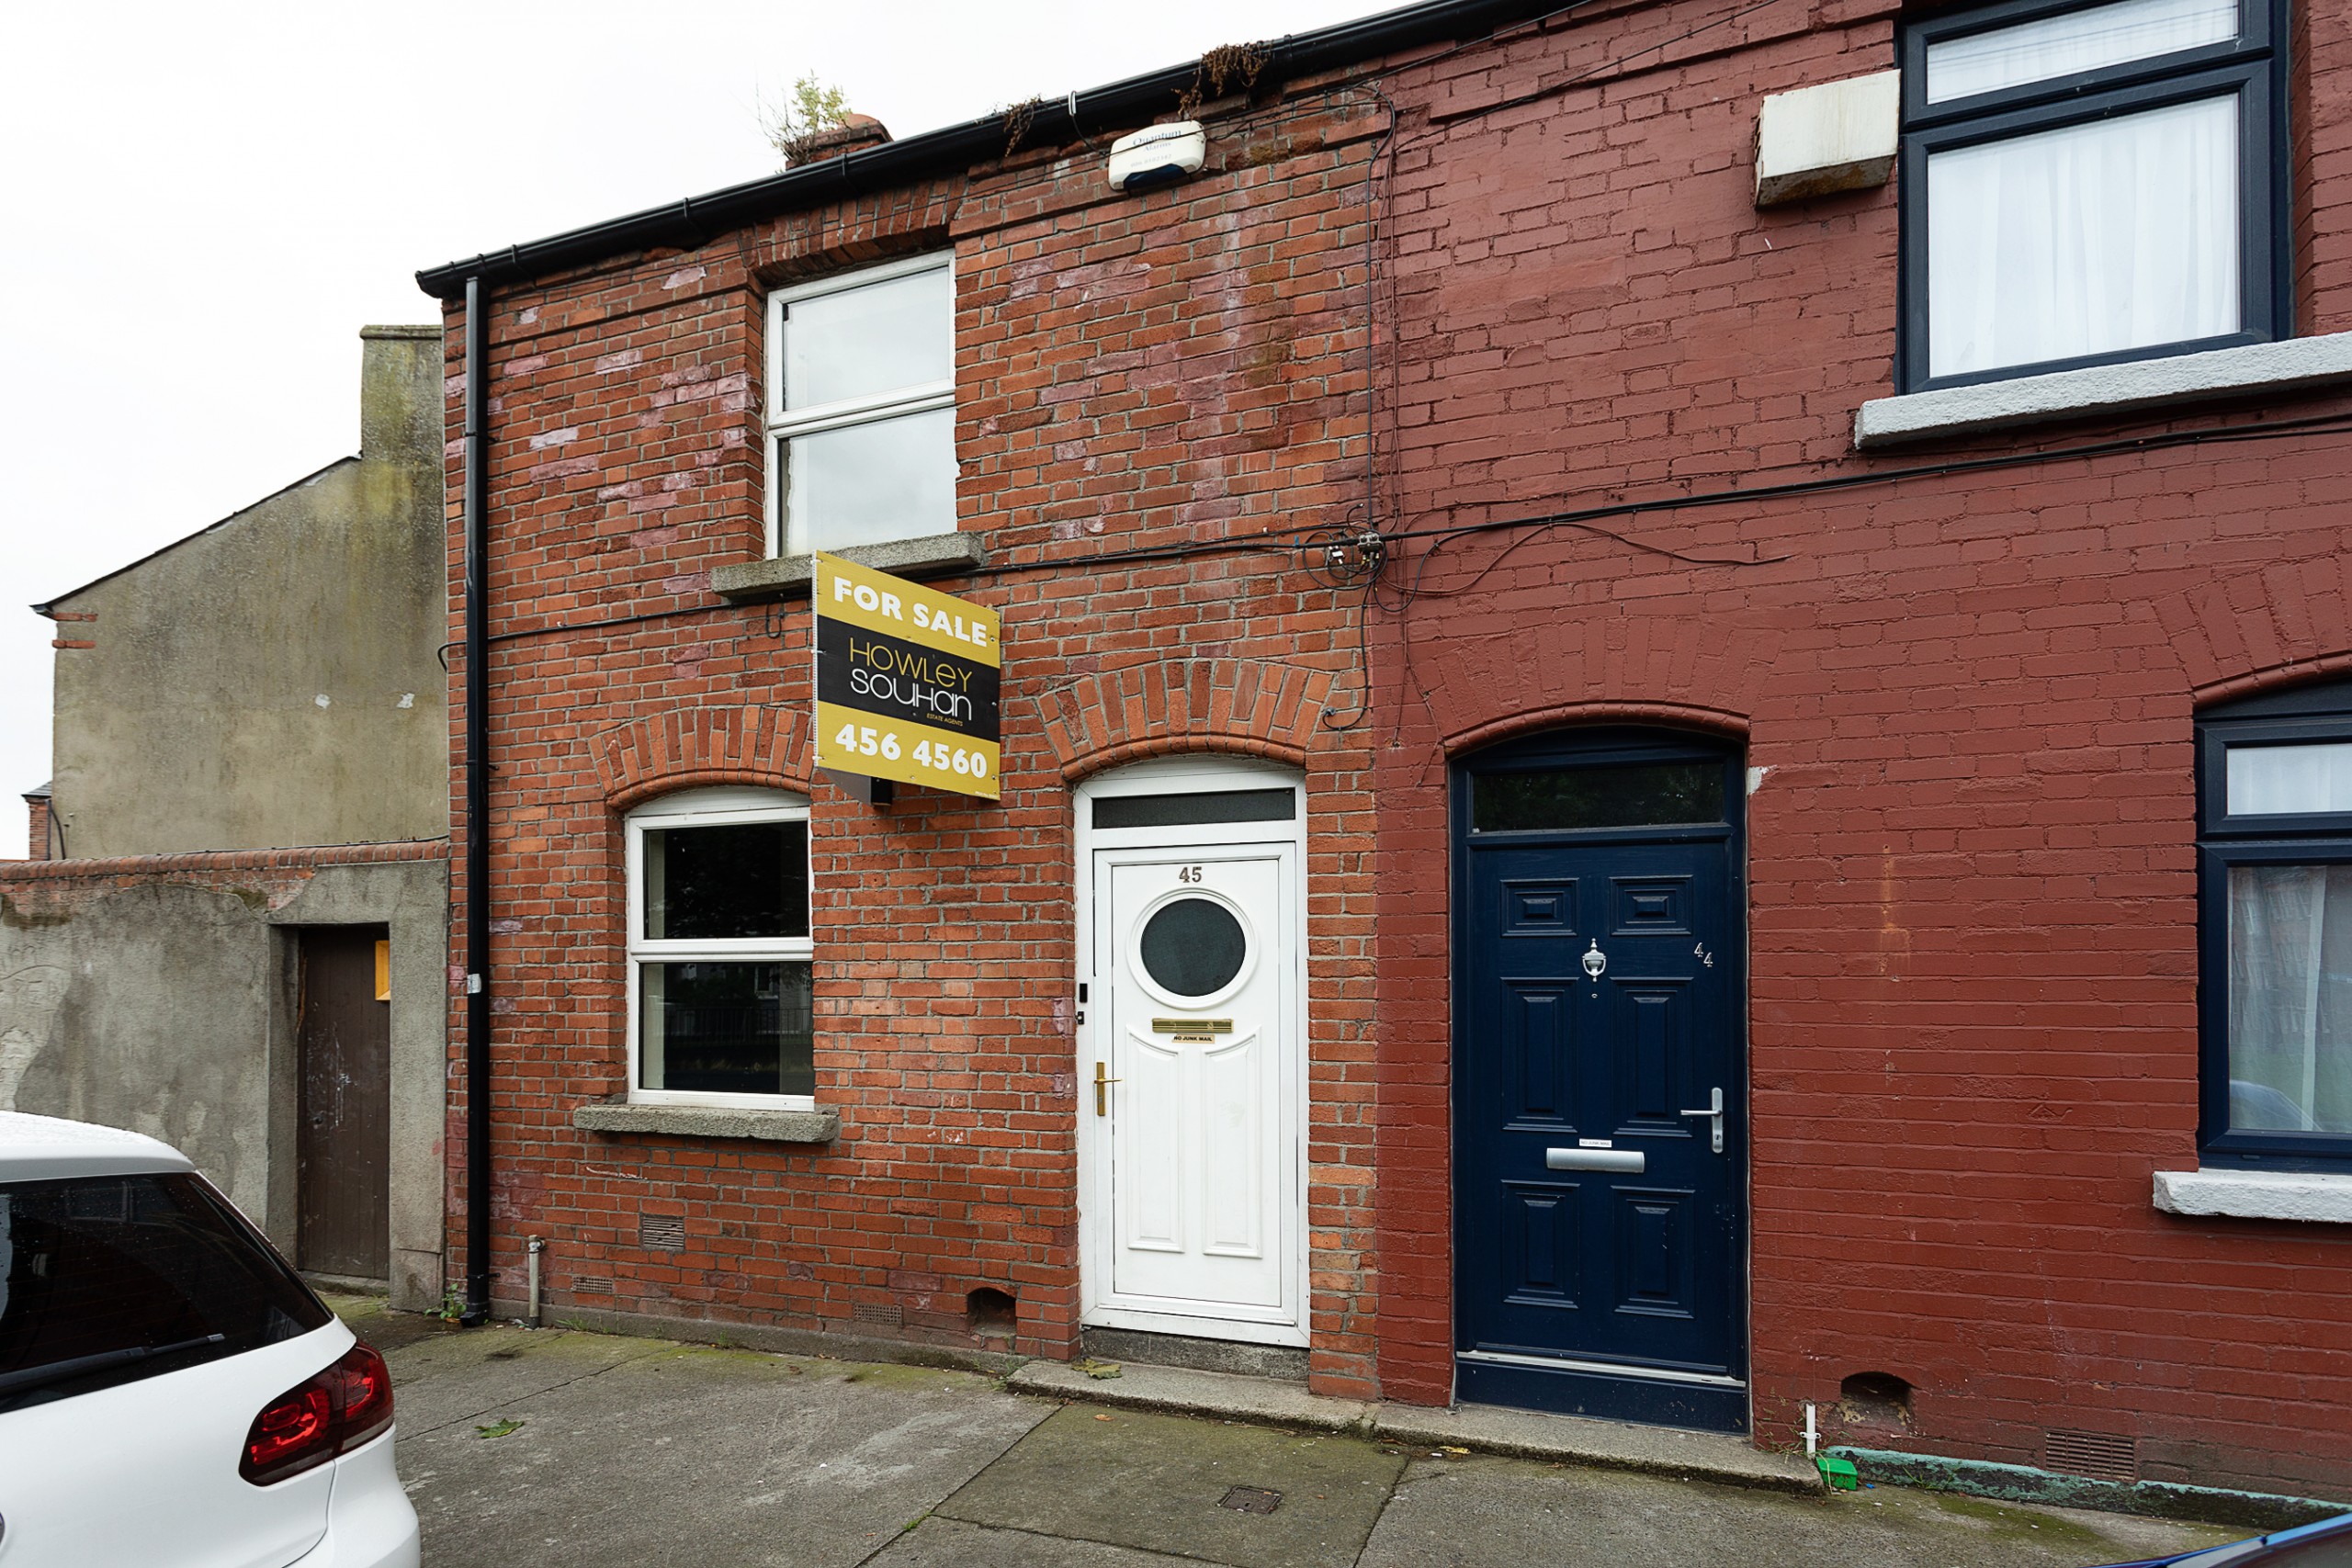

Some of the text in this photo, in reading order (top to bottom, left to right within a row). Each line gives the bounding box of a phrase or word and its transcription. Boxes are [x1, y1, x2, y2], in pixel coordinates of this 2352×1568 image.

[833, 576, 988, 648] FOR SALE
[926, 713, 964, 727] ESTATE AGENTS
[835, 723, 988, 779] 456 4560
[1179, 866, 1203, 883] 45
